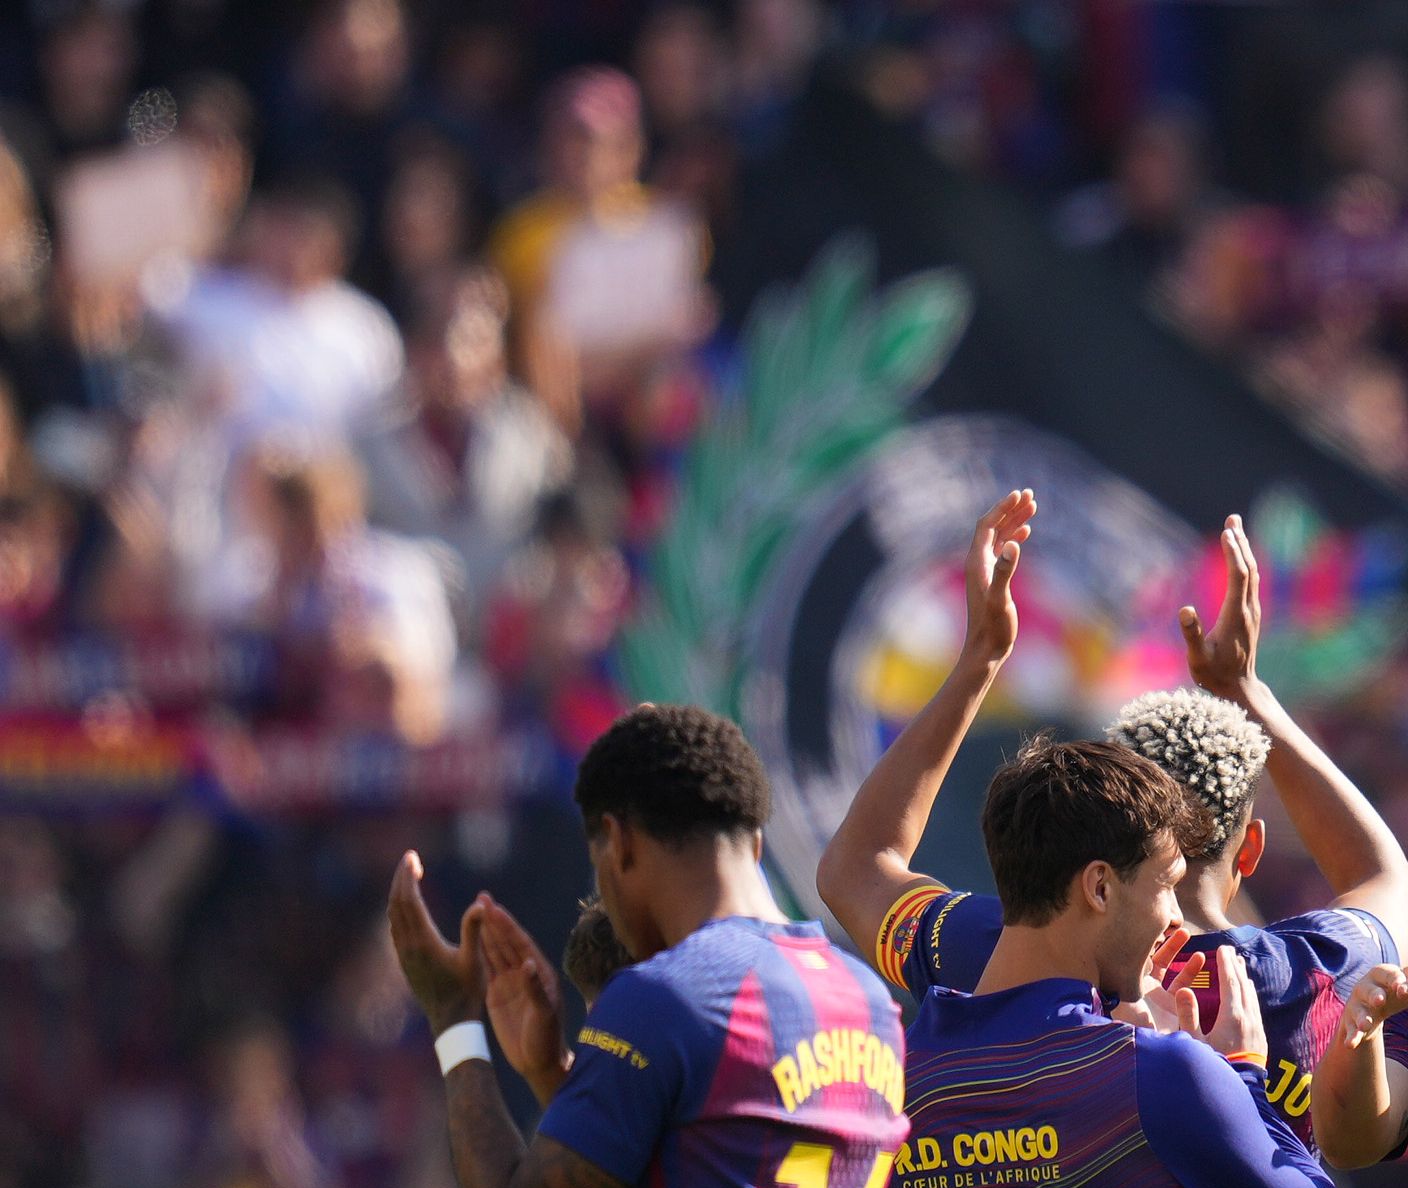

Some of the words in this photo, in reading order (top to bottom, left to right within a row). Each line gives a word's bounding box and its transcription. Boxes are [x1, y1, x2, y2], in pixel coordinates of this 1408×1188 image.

[894, 1136, 949, 1176] R.D.
[952, 1124, 1060, 1168] CONGO
[954, 1170, 975, 1188] DE
[980, 1163, 1062, 1186] L'AFRIQUE
